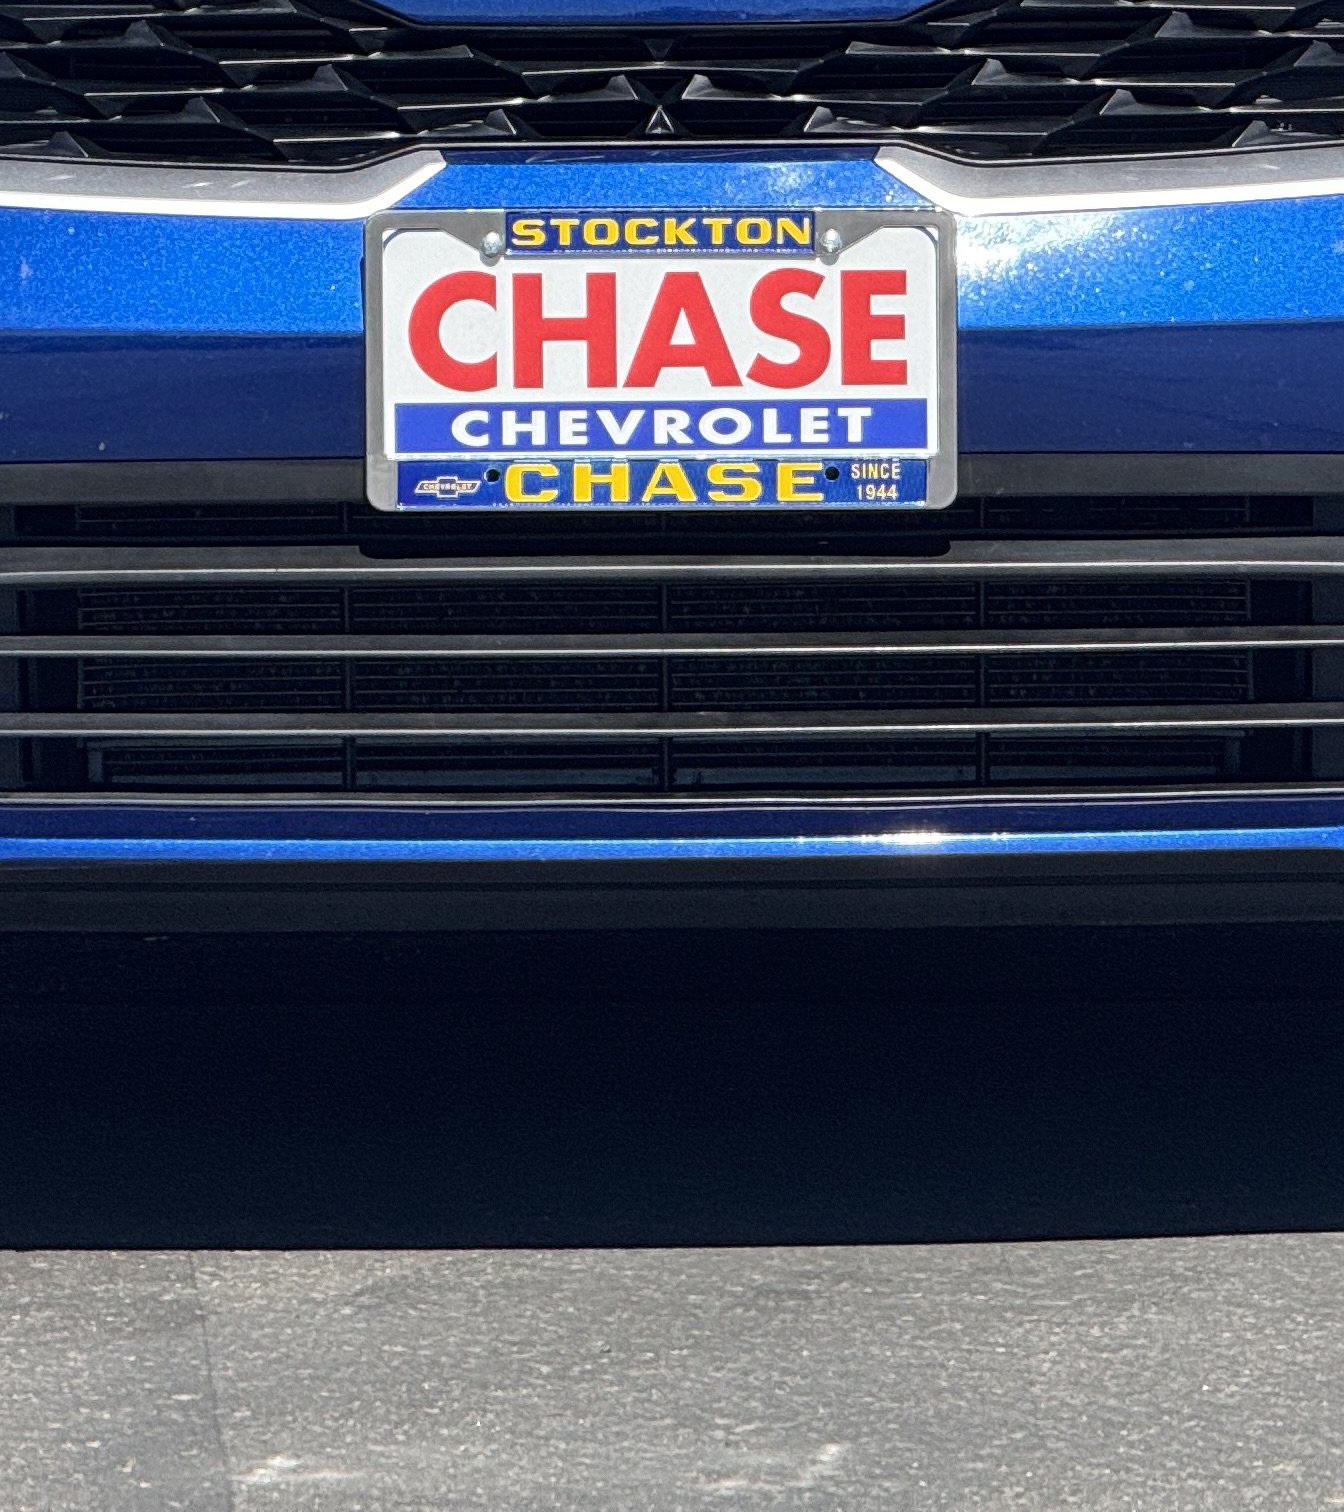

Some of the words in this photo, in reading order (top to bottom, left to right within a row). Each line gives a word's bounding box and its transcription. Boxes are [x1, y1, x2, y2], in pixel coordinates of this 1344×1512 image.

[511, 217, 811, 246] STOCKTON
[408, 267, 908, 393] CHASE
[452, 407, 872, 446] CHEVROLET
[505, 462, 824, 504] CHASE
[850, 462, 901, 481] SINCE
[856, 483, 899, 501] 1944
